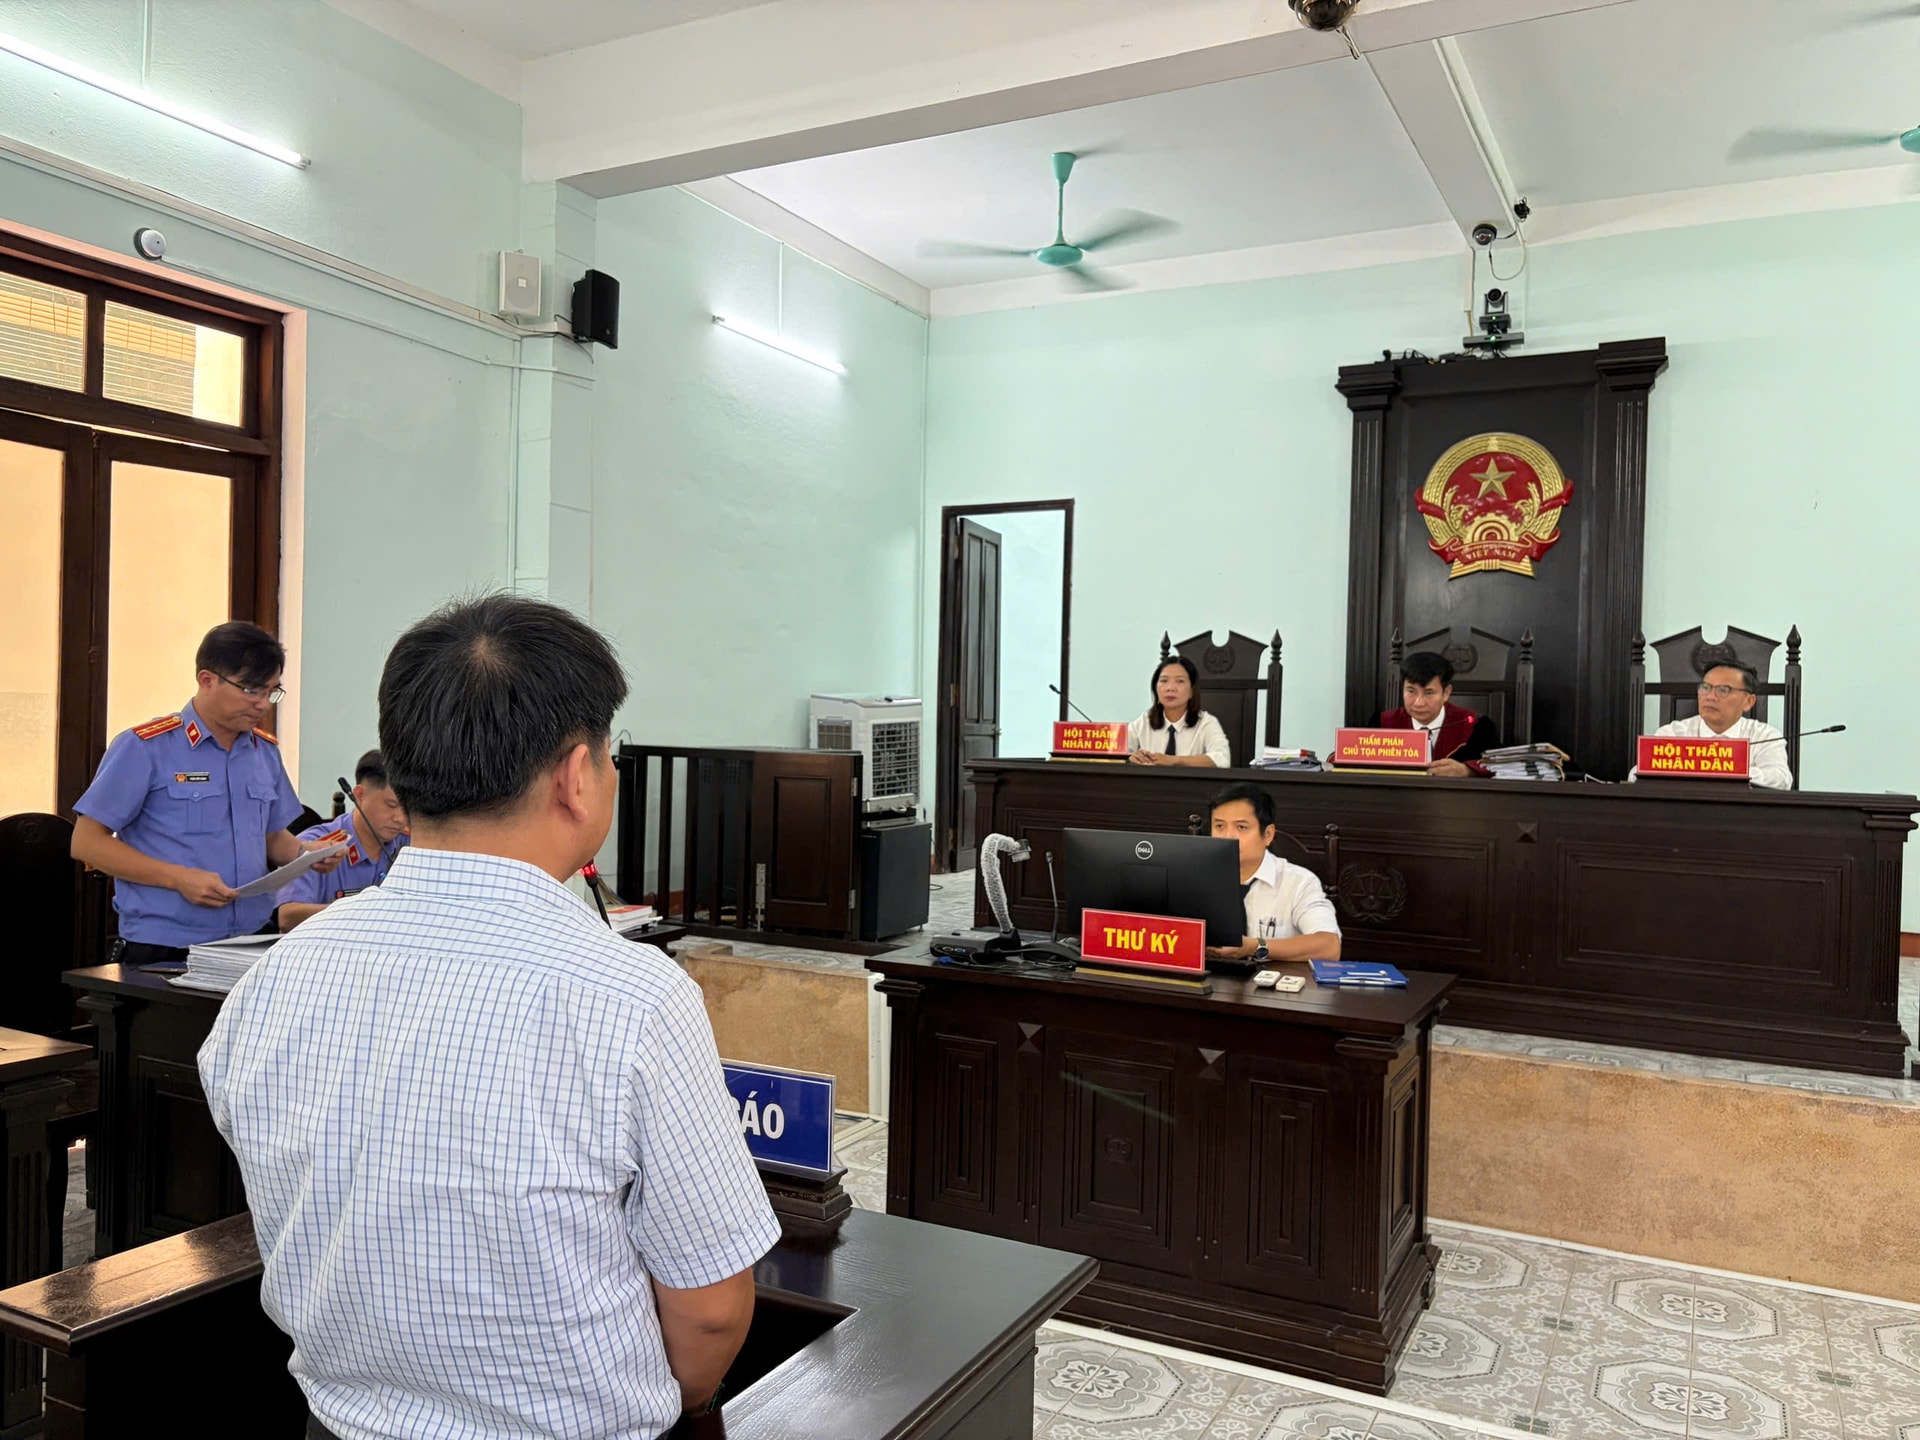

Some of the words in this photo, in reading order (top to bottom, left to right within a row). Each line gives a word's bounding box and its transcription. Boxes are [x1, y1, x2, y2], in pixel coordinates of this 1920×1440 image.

[1063, 727, 1083, 739] HỘI
[1085, 726, 1117, 739] THẨM
[1062, 738, 1092, 749] NHÂN
[1095, 739, 1118, 750] DÂN
[1382, 736, 1404, 747] PHÁN
[1343, 745, 1359, 756] CHỦ
[1361, 747, 1376, 758] TỌA
[1378, 747, 1401, 757] PHIÊN
[1403, 748, 1419, 758] TÒA
[1653, 743, 1681, 758] HỘI
[1686, 742, 1733, 758] THẨM
[1652, 757, 1695, 770] NHÂN
[1700, 758, 1734, 771] DÂN
[1103, 927, 1147, 951] THƯ
[1150, 929, 1179, 955] KÝ
[730, 1090, 785, 1139] ÁO
